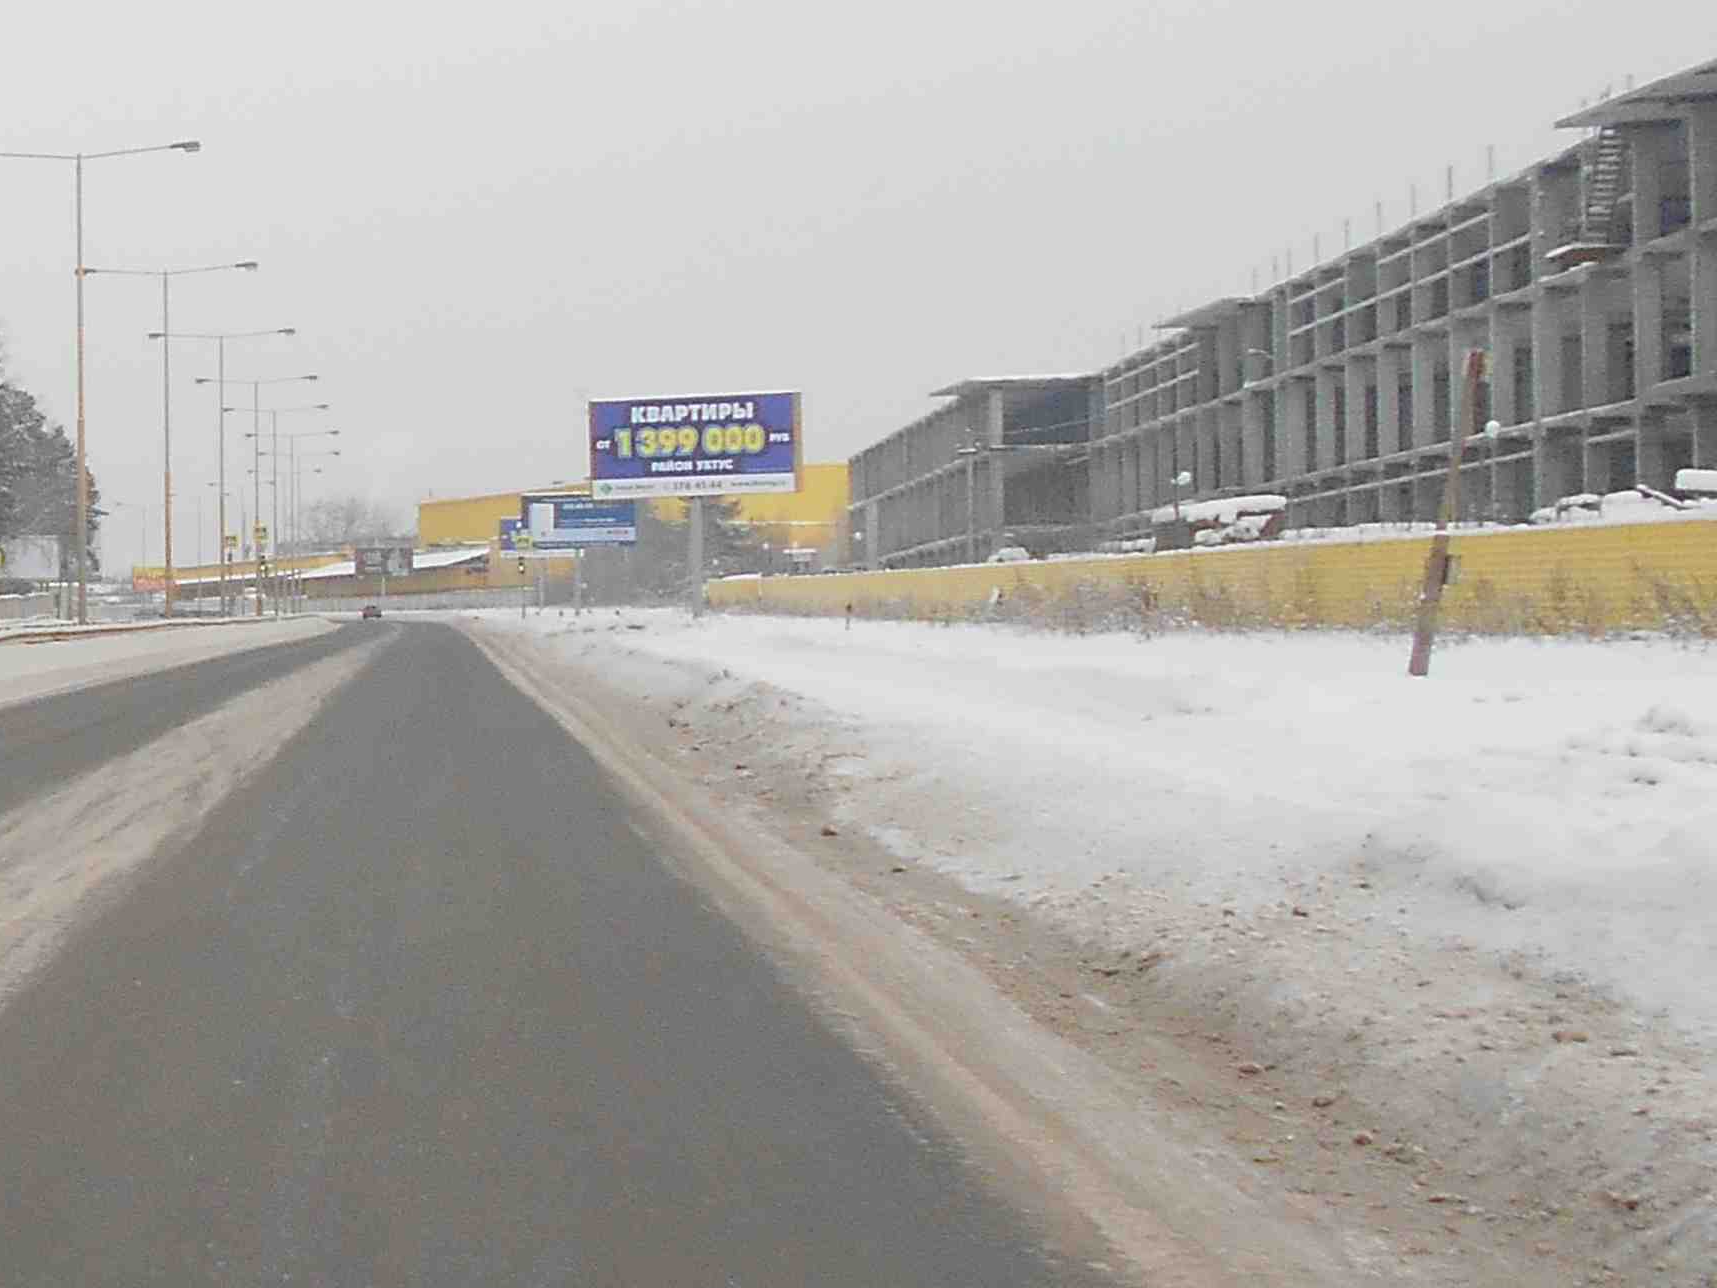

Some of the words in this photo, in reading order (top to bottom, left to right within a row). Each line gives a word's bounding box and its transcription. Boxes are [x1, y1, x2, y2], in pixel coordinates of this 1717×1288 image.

[631, 402, 754, 424] КВАРТИРЫ
[635, 425, 699, 458] 399
[701, 423, 766, 456] 000
[651, 459, 693, 472] РАЙОН
[696, 459, 734, 472] УКТУС
